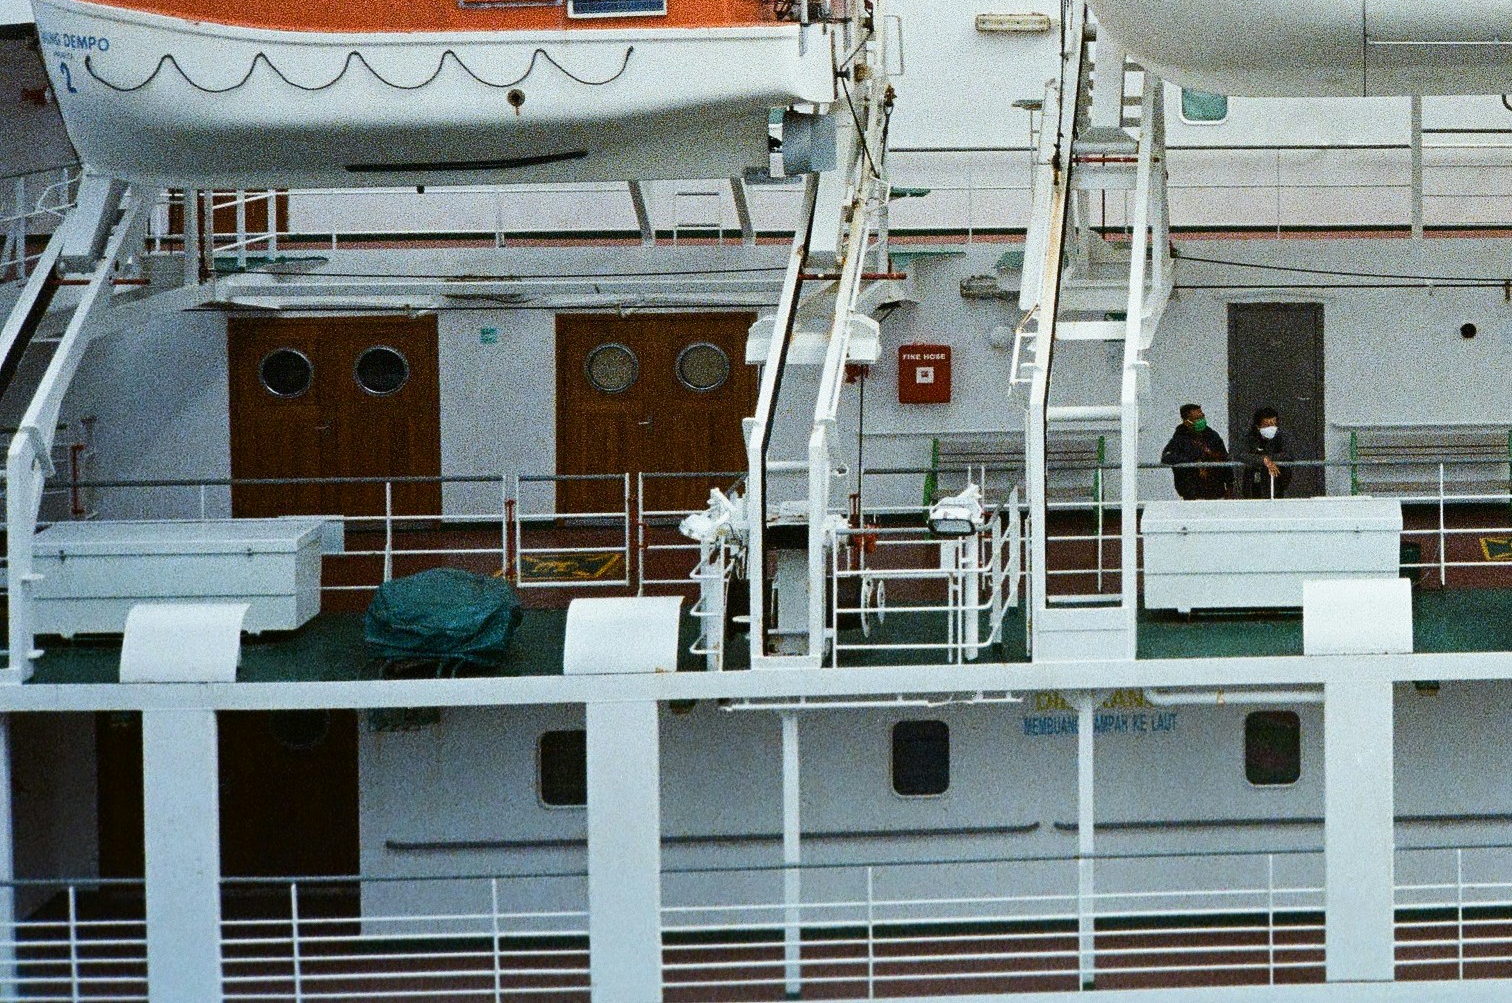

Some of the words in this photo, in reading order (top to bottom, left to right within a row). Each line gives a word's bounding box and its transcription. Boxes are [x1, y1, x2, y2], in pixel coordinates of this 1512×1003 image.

[63, 33, 110, 52] DEMPO
[60, 62, 78, 94] 2
[902, 353, 921, 361] FIRE
[1093, 713, 1128, 734] AMPAH
